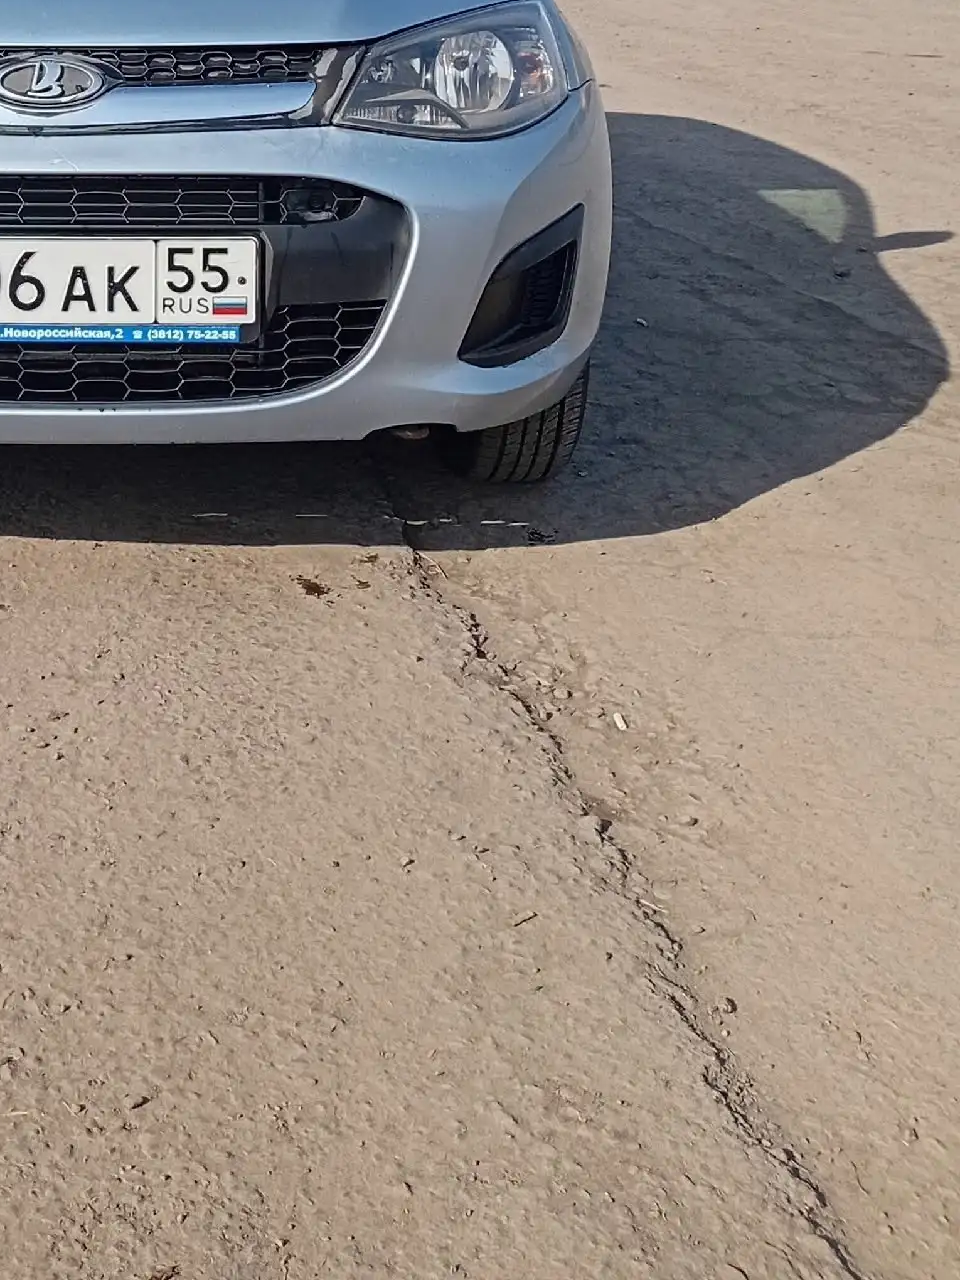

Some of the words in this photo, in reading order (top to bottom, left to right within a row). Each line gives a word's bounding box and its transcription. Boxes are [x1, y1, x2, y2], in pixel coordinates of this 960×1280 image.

[165, 247, 230, 293] 55
[162, 298, 209, 315] RUS
[147, 328, 183, 340] (3812)
[187, 329, 236, 339] 75-22-55
